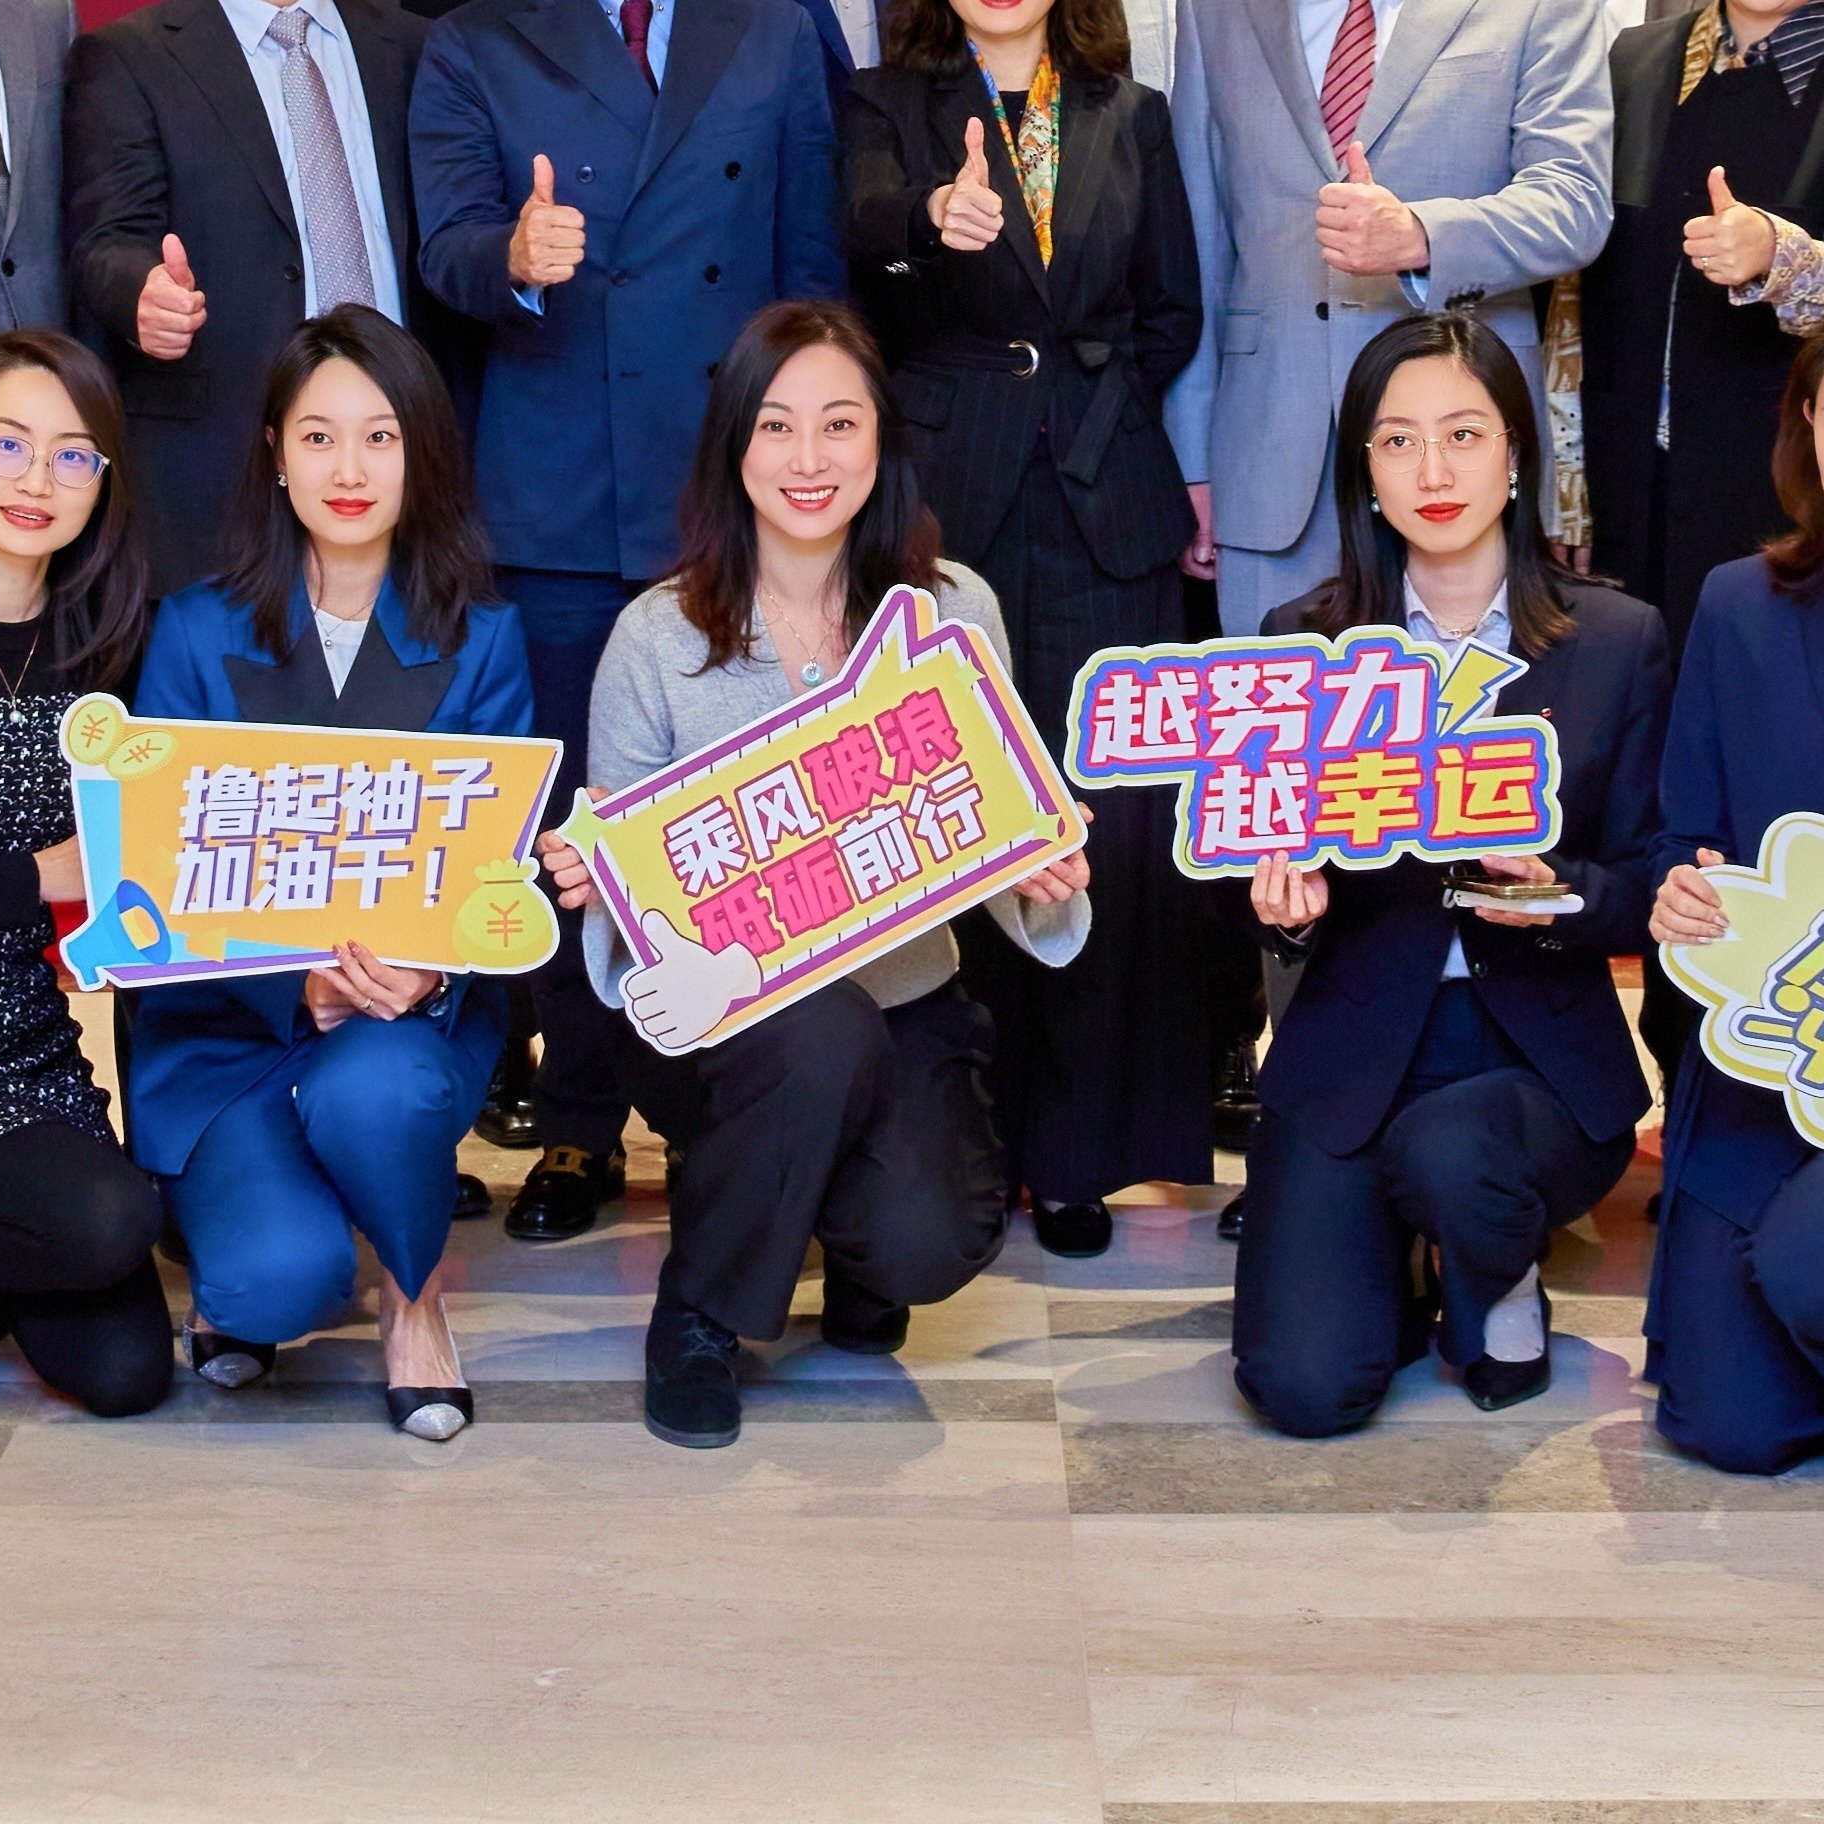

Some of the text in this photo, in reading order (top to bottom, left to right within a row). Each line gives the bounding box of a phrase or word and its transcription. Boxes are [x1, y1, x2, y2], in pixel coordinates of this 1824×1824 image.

[1090, 651, 1429, 763] 越努力
[179, 758, 499, 839] 撸起袖子
[664, 687, 962, 897] 乘风破浪
[1199, 742, 1537, 854] 越幸运
[689, 762, 986, 958] 砥砺前行
